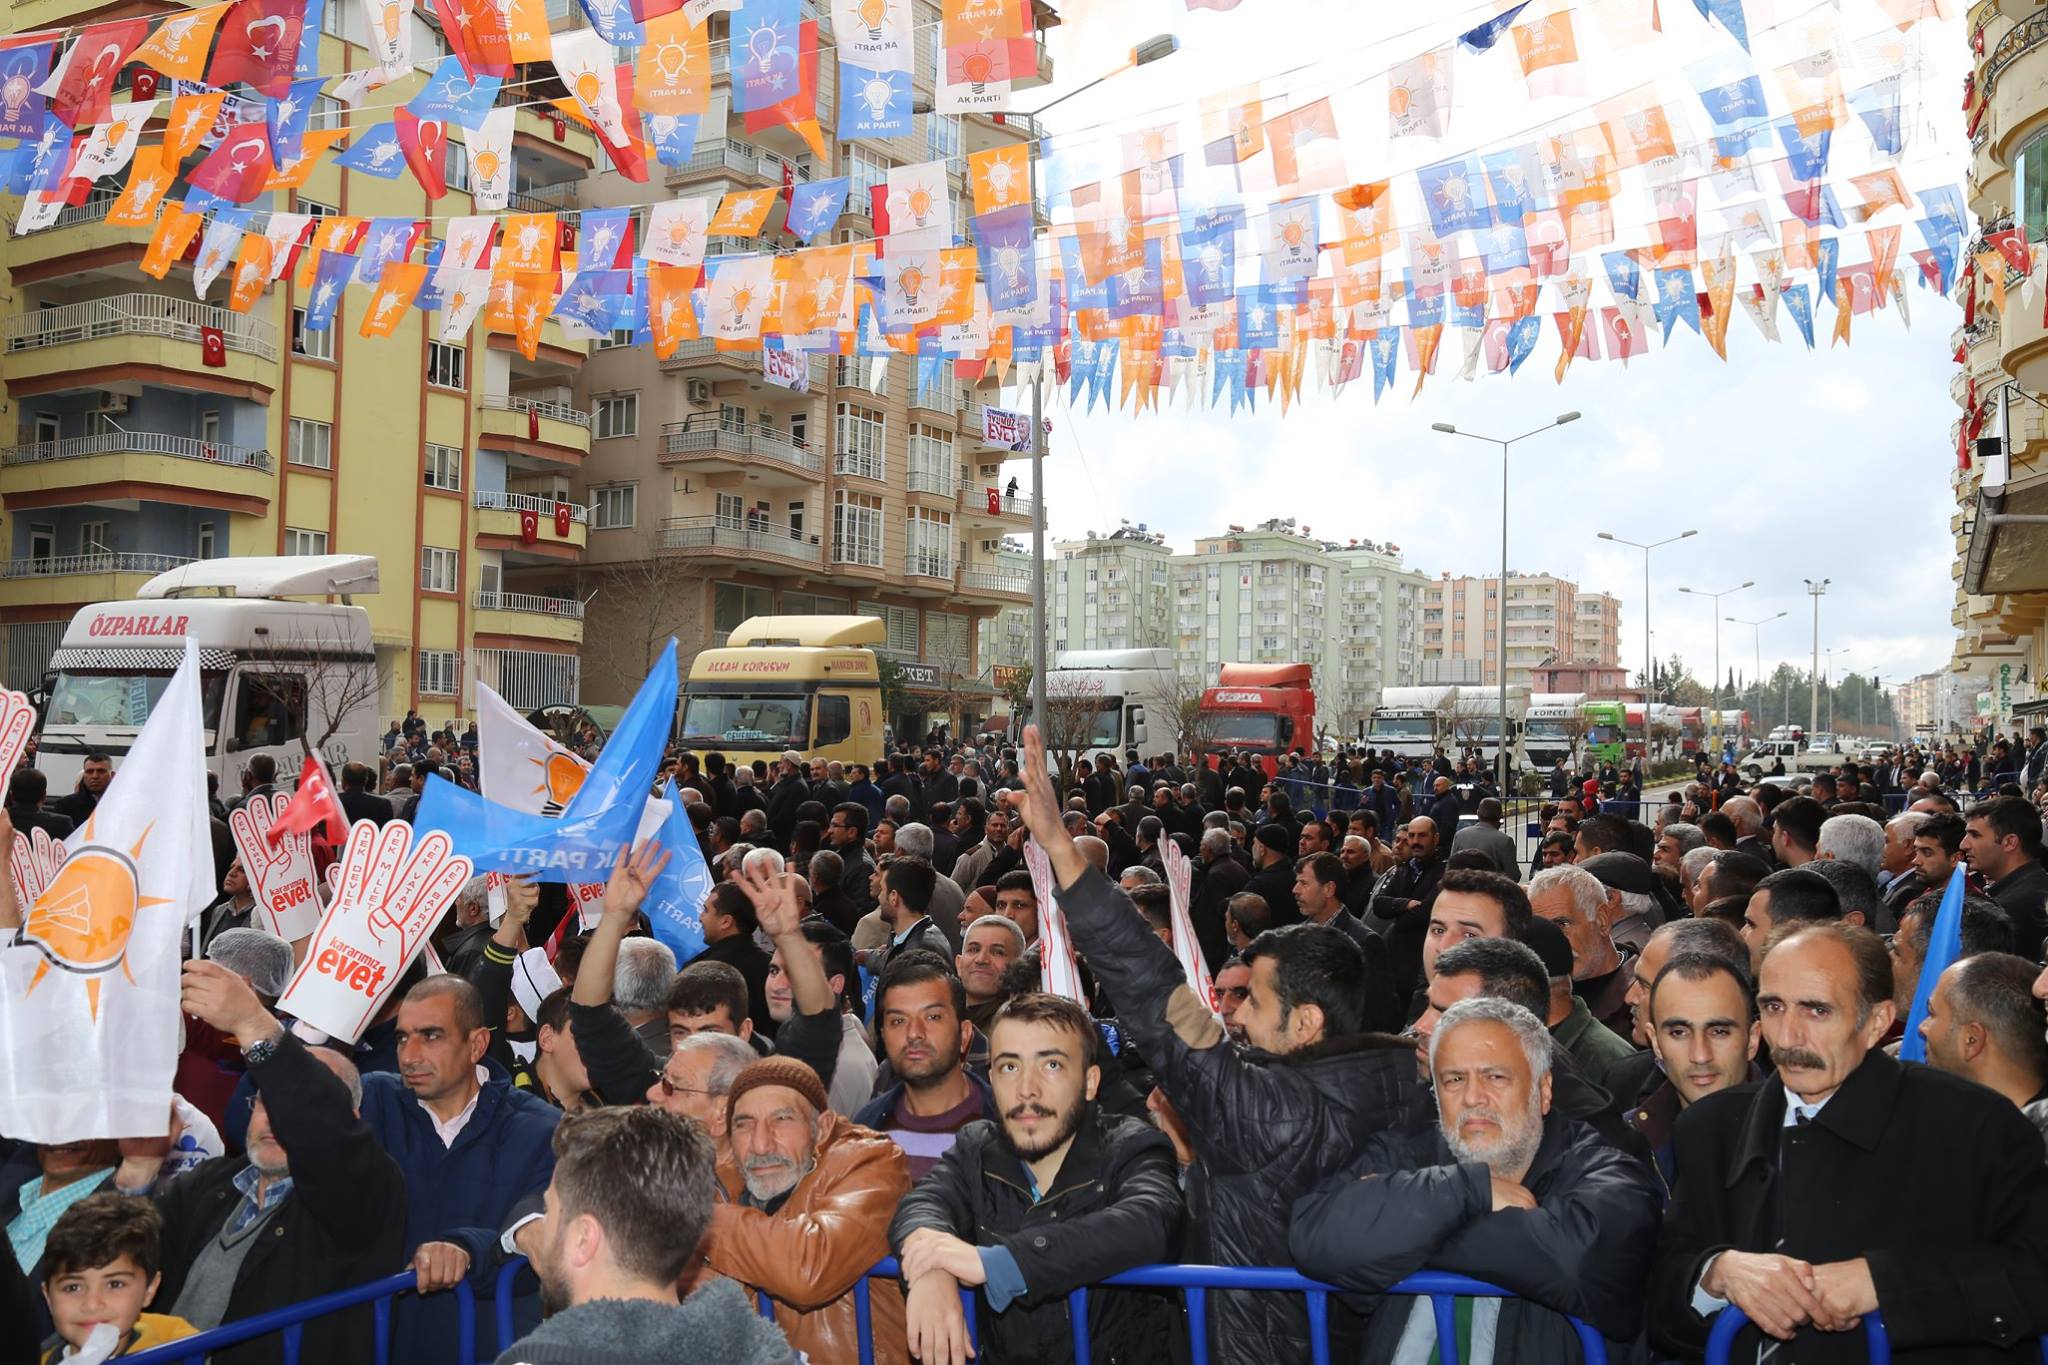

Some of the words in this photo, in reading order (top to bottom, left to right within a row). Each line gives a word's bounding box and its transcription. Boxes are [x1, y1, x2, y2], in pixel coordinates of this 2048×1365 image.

[957, 96, 971, 104] AK
[974, 95, 1001, 104] PARTİ
[857, 122, 872, 130] AK
[873, 121, 901, 130] PARTİ
[894, 308, 905, 316] AK
[908, 308, 929, 316] PARTİ
[1120, 297, 1130, 306] AK
[1132, 295, 1153, 304] PARTİ
[89, 614, 190, 638] ÖZPARLAR
[707, 662, 738, 673] ALLAH
[12, 713, 26, 736] TEK
[358, 831, 371, 856] TEK
[388, 830, 402, 855] TEK
[422, 844, 441, 868] TEK
[443, 865, 462, 886] TEK
[272, 884, 312, 912] evet
[344, 865, 362, 915] DEVLET
[395, 872, 422, 912] VATAN
[408, 891, 441, 936] BAYRAK
[329, 936, 381, 971] kararımız
[316, 948, 388, 998] evet
